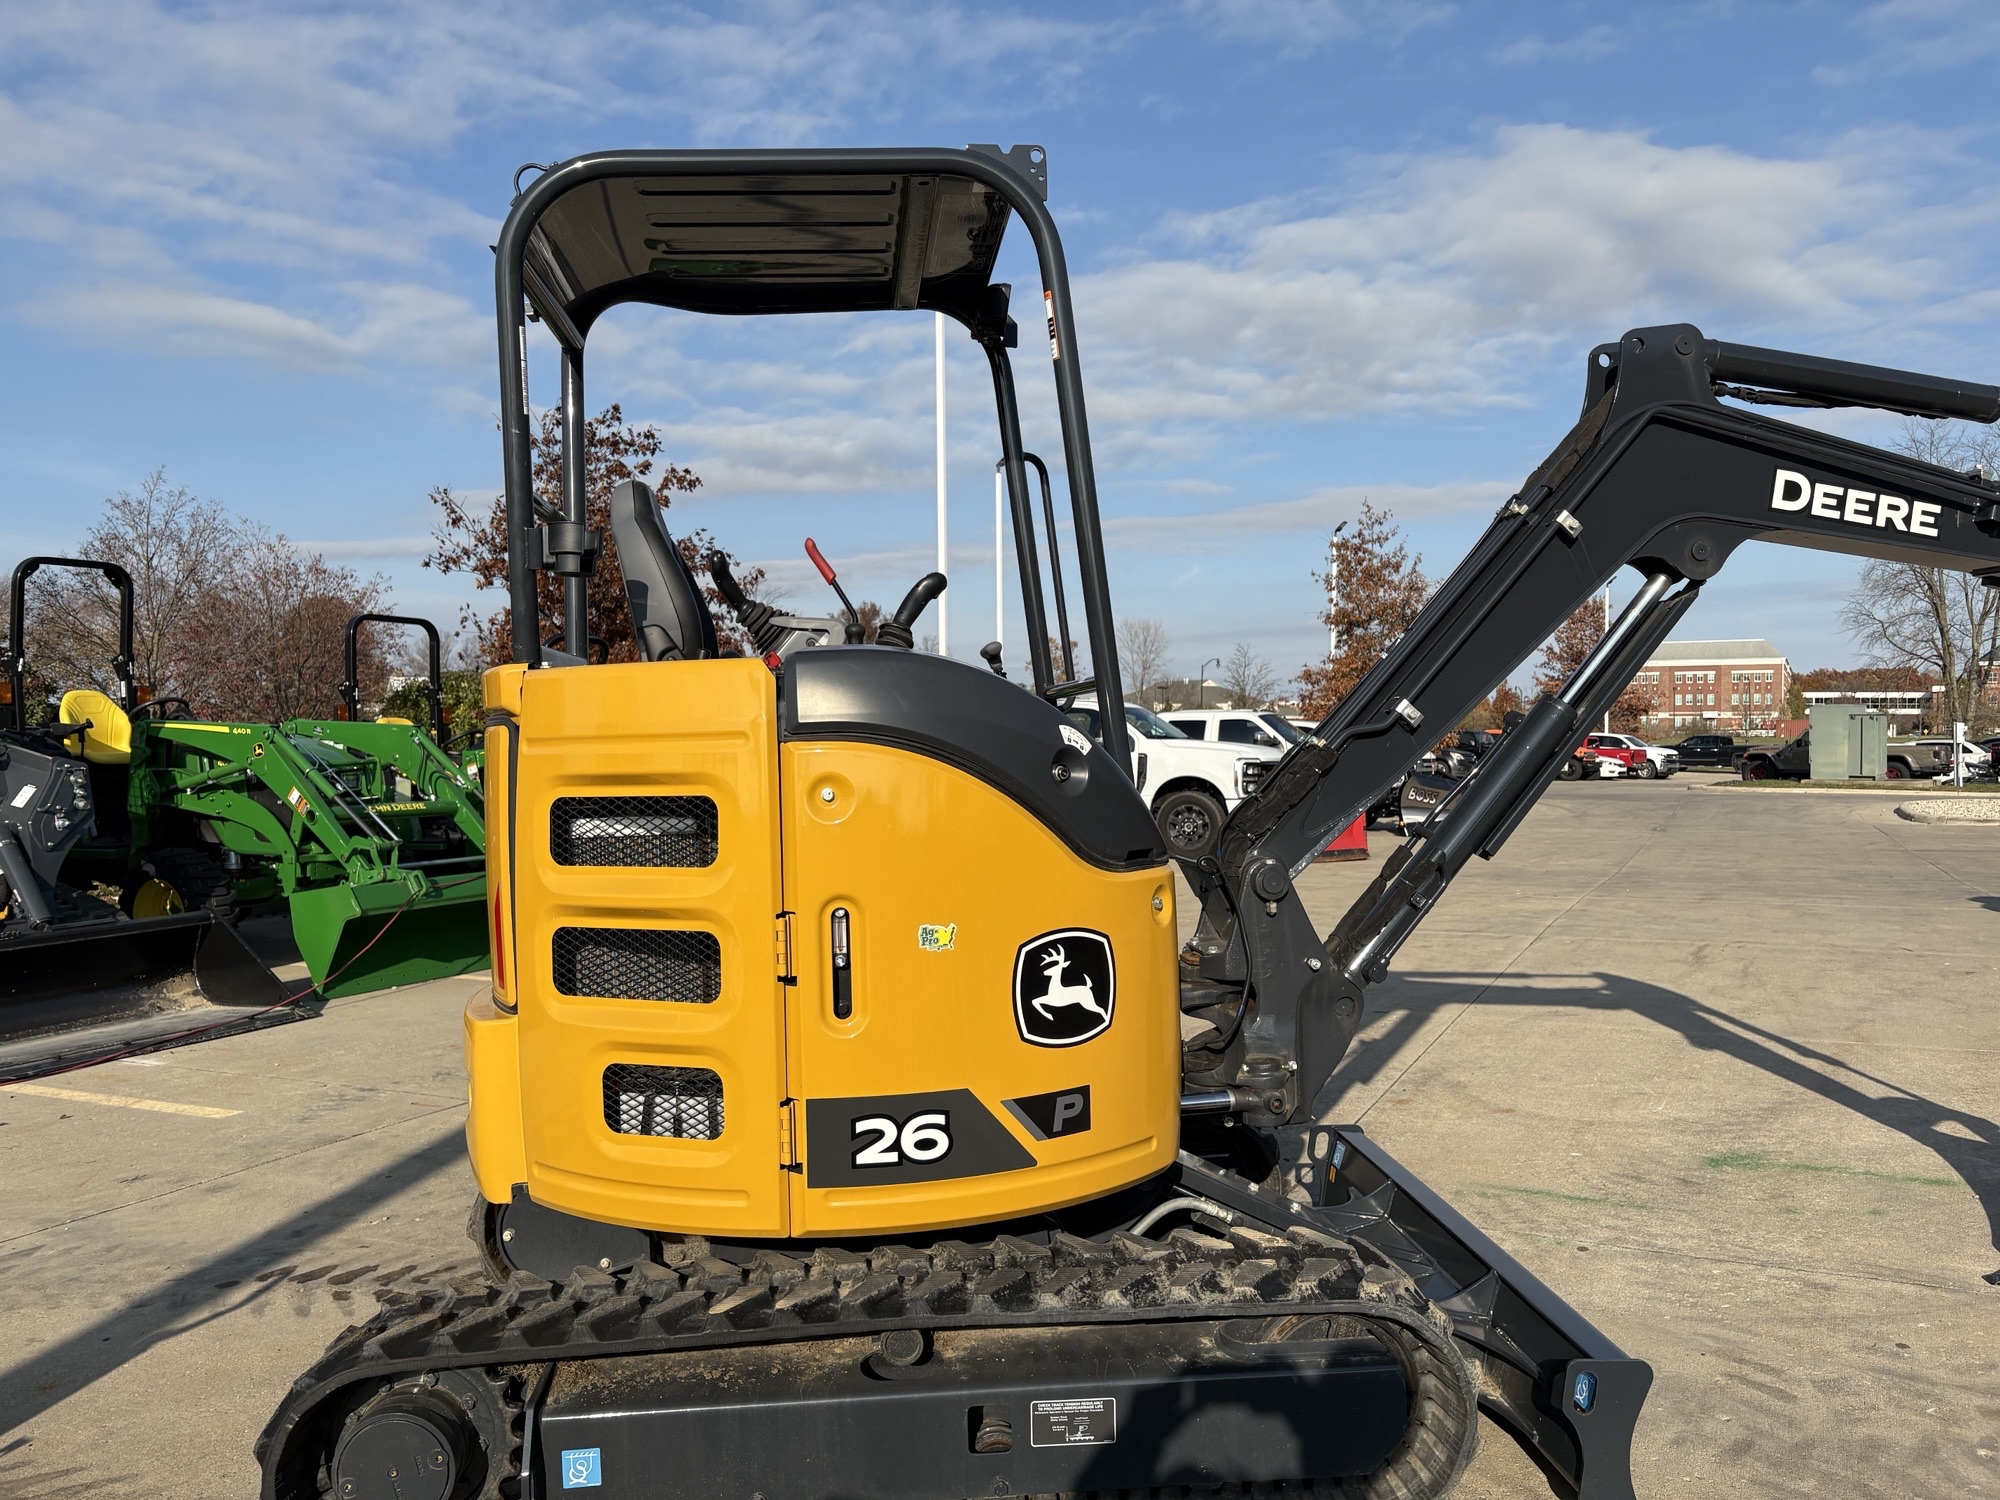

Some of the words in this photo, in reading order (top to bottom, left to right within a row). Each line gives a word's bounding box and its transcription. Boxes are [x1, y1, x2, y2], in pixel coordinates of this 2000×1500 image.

[1770, 468, 1942, 538] DEERE
[392, 803, 427, 812] DEERE
[1408, 787, 1439, 804] BOSS
[921, 936, 939, 946] Pro
[1052, 1093, 1084, 1133] P
[854, 1113, 951, 1166] 26
